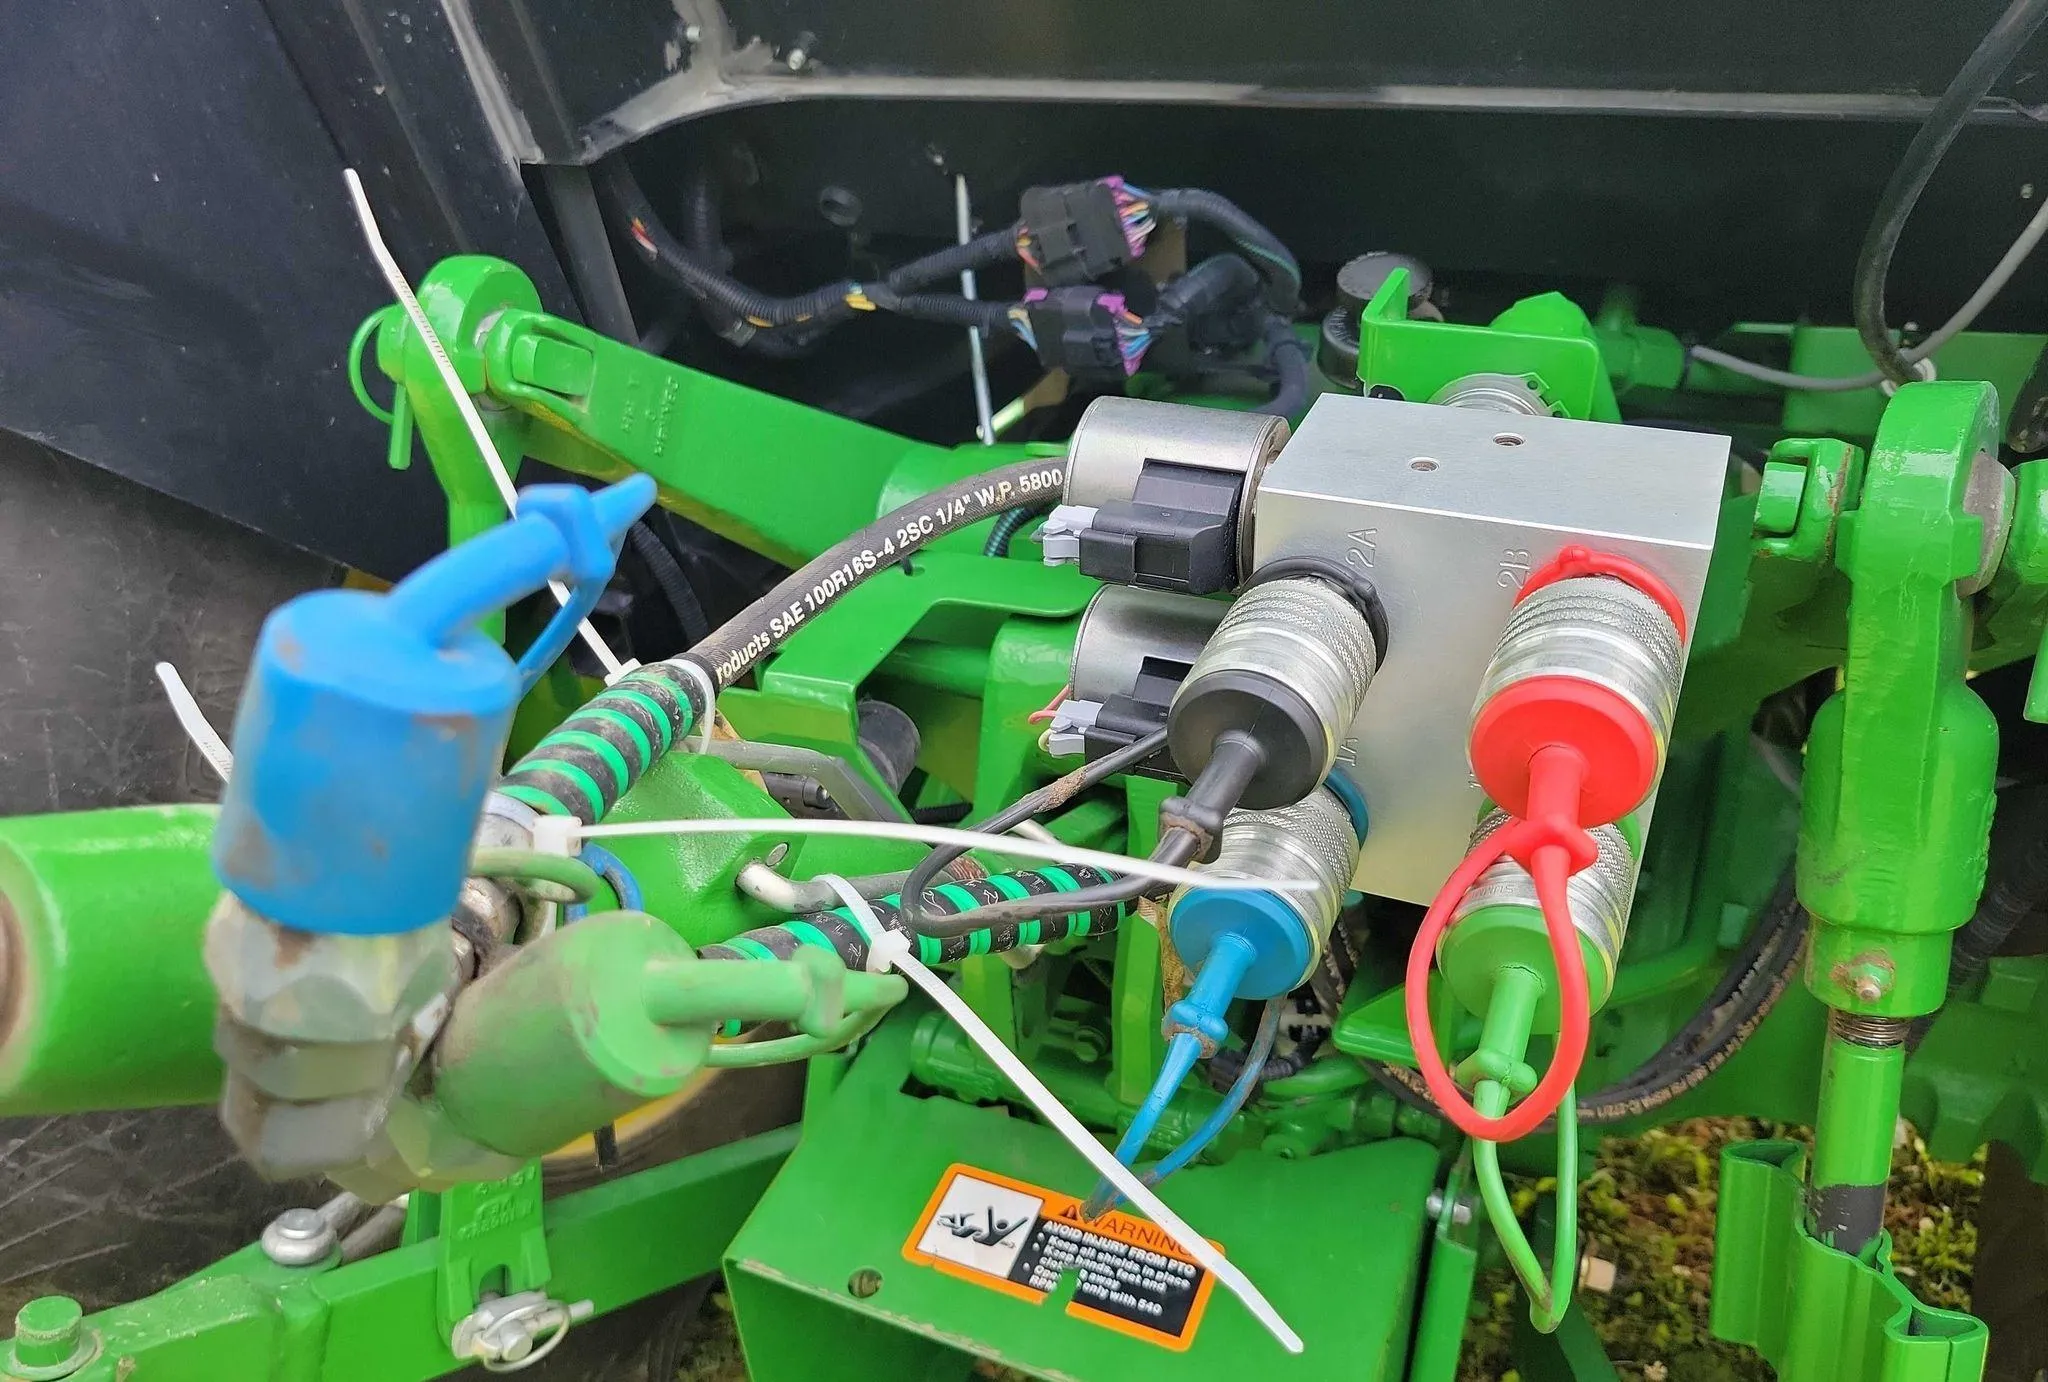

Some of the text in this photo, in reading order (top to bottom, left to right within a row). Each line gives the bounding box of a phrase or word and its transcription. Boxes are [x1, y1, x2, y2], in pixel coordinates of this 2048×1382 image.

[1345, 528, 1378, 568] 2A
[1497, 548, 1531, 589] 2B
[716, 468, 1064, 685] roducts SAE 100R16S-4 2SC 1/4" W.P. 5800
[1042, 1220, 1197, 1279] AVOID INJURY FROM PTO
[1043, 1244, 1075, 1266] Keep
[1116, 1267, 1143, 1286] feet
[1141, 1277, 1167, 1295] and
[1047, 1235, 1079, 1256] Keep
[1079, 1246, 1098, 1261] all
[1096, 1251, 1141, 1275] shields
[1141, 1264, 1156, 1279] in
[1082, 1281, 1110, 1300] only
[1109, 1290, 1137, 1309] with
[1137, 1298, 1163, 1317] 540
